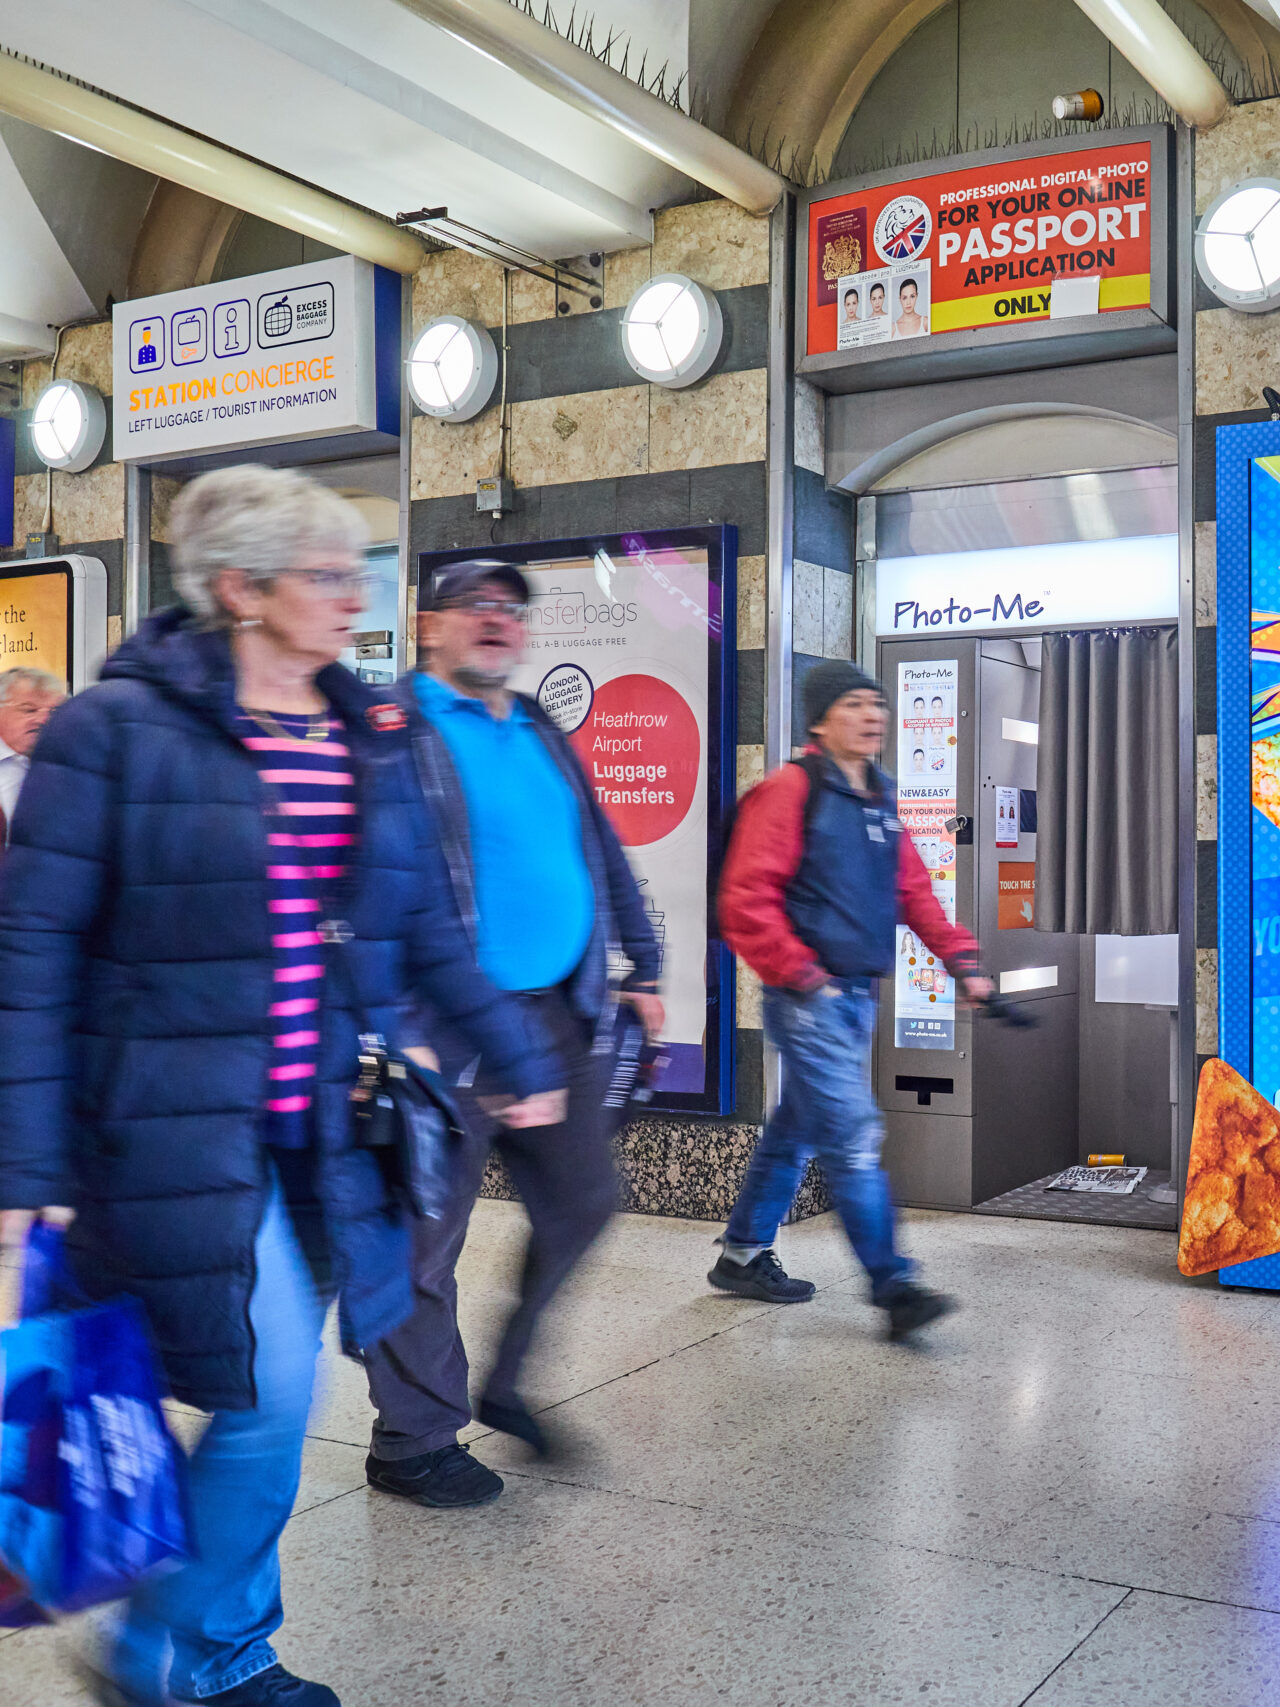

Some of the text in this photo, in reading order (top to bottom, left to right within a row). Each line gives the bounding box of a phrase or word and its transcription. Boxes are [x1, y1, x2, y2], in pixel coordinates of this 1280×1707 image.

[940, 160, 1149, 206] PROFESSIONAL DIGITAL PHOTO
[937, 178, 1145, 229] FOR YOUR ONLINE
[939, 202, 1147, 267] PASSPORT
[964, 247, 1116, 287] APPLICATION
[296, 299, 328, 313] EXCESS
[994, 292, 1051, 317] ONLY
[296, 309, 328, 322] BAGGAGE
[296, 318, 328, 330] COMPANY
[128, 355, 336, 412] STATION CONCIERGE
[128, 418, 153, 433] LEFT
[154, 409, 204, 430] LUGGAGE
[212, 401, 258, 420] TOURIST
[259, 387, 338, 412] INFORMATION
[4, 604, 27, 624] the
[524, 599, 638, 628] nsferbags
[894, 593, 1044, 628] Photo-Me
[0, 631, 38, 656] land.
[544, 640, 560, 648] A-B
[562, 638, 603, 648] LUGGAGE
[605, 637, 627, 646] FREE
[545, 673, 580, 692] LONDON
[904, 668, 954, 679] Photo-Me
[544, 683, 583, 702] LUGGAGE
[545, 693, 584, 713] DELIVERY
[593, 711, 668, 728] Heathrow
[592, 735, 642, 756] Airport
[593, 761, 667, 783] Luggage
[595, 786, 675, 805] Transfers
[900, 788, 950, 798] NEW&EASY
[899, 815, 956, 827] PASSPO
[934, 807, 956, 815] ONLIN
[1000, 880, 1019, 890] TOUCH
[1020, 880, 1031, 889] THE
